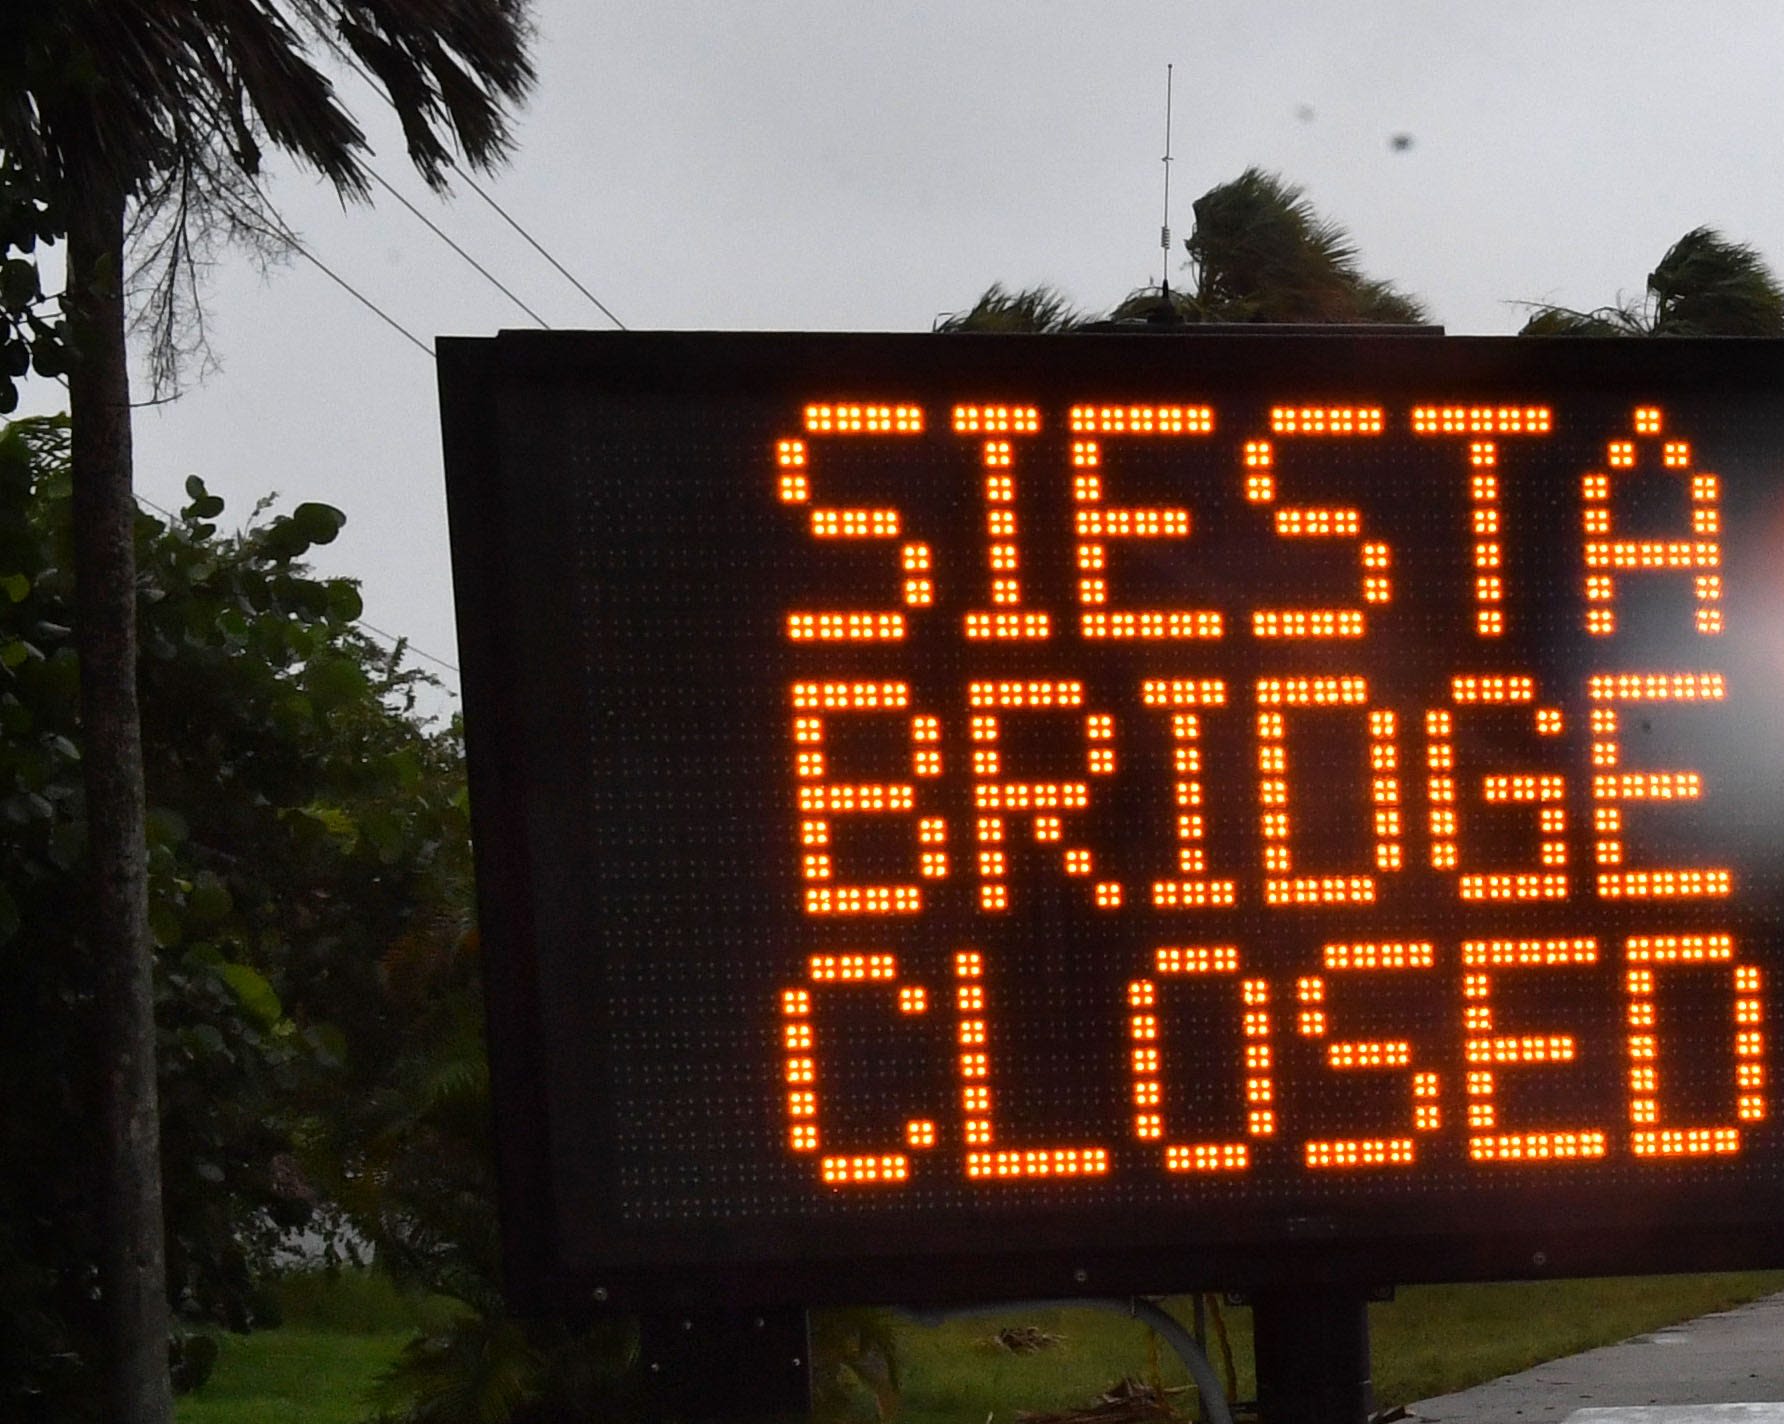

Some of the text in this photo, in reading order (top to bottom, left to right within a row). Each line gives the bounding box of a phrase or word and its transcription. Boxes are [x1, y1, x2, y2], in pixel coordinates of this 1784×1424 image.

[778, 405, 1723, 638] SIESTA
[792, 673, 1729, 914] BRIDGE
[783, 934, 1763, 1183] CLOSED
